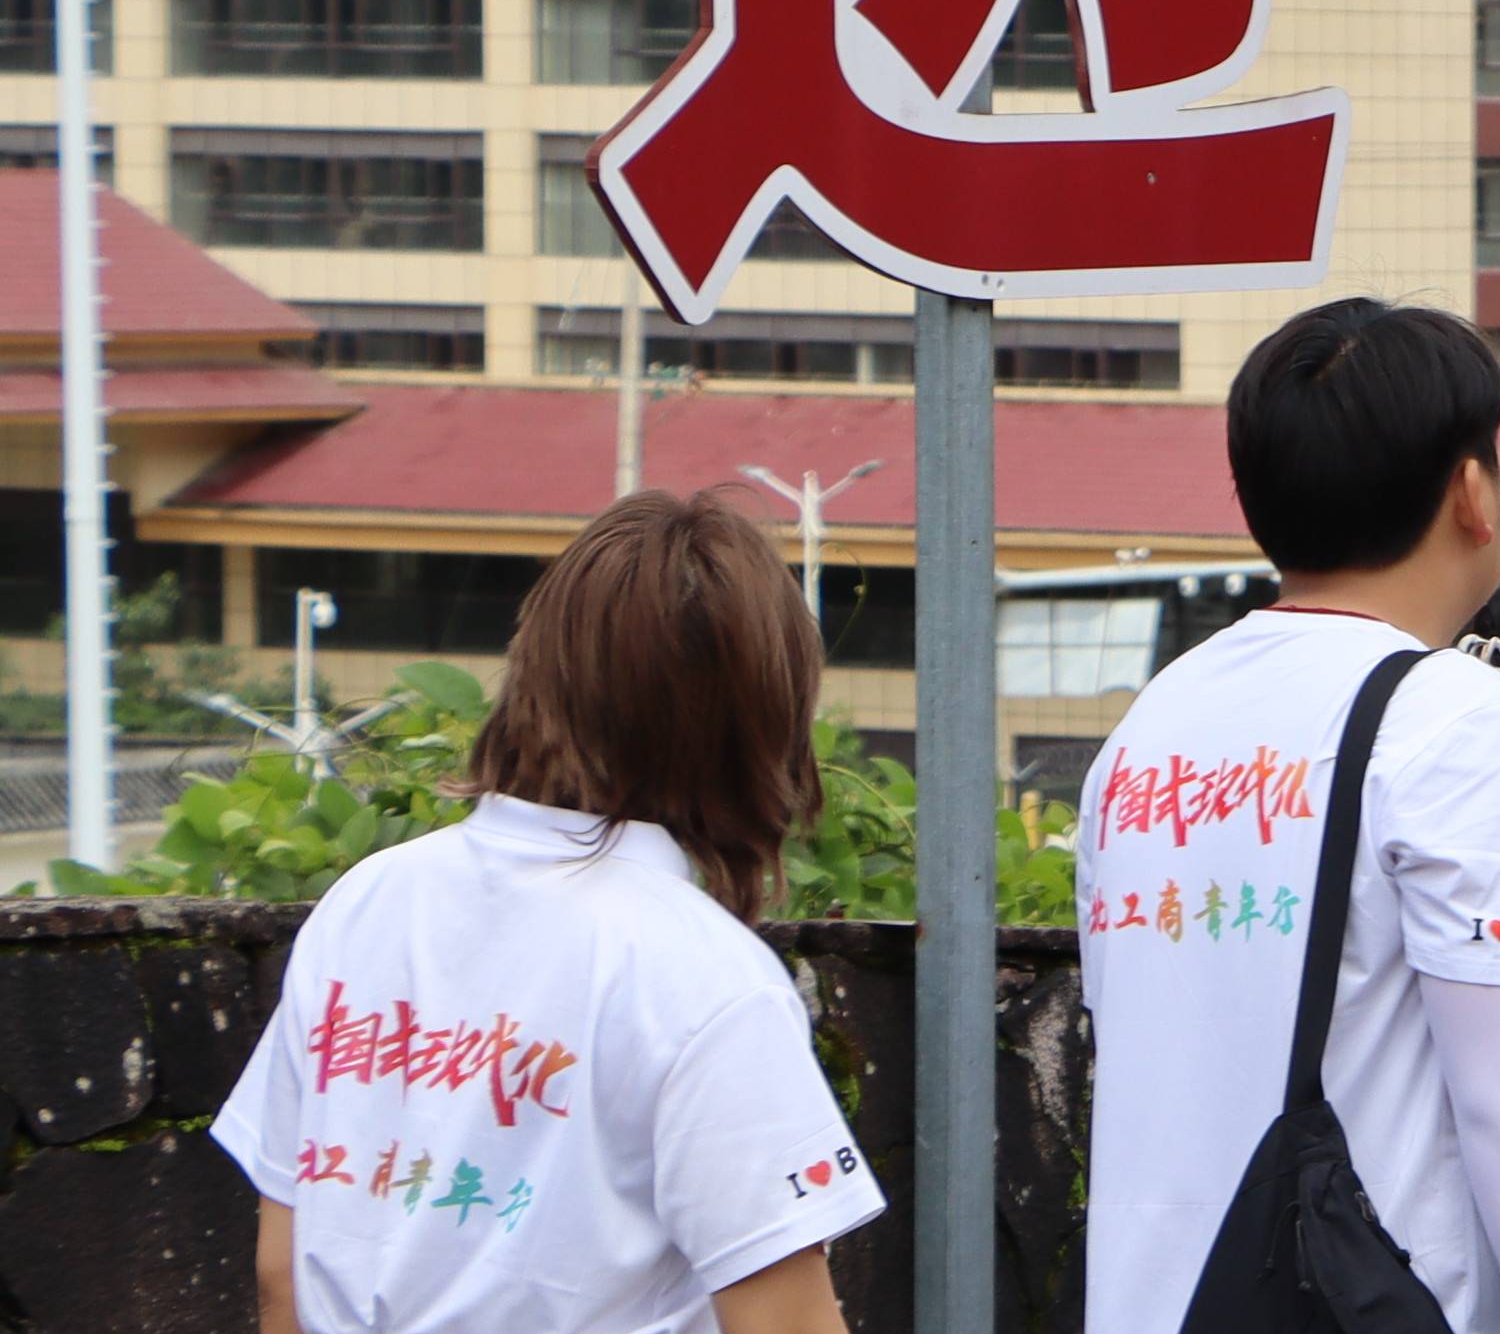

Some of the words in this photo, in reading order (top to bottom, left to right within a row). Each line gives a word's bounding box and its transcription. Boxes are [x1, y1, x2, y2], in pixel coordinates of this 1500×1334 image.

[1100, 746, 1314, 851] 中国式现代化
[1473, 919, 1484, 941] I
